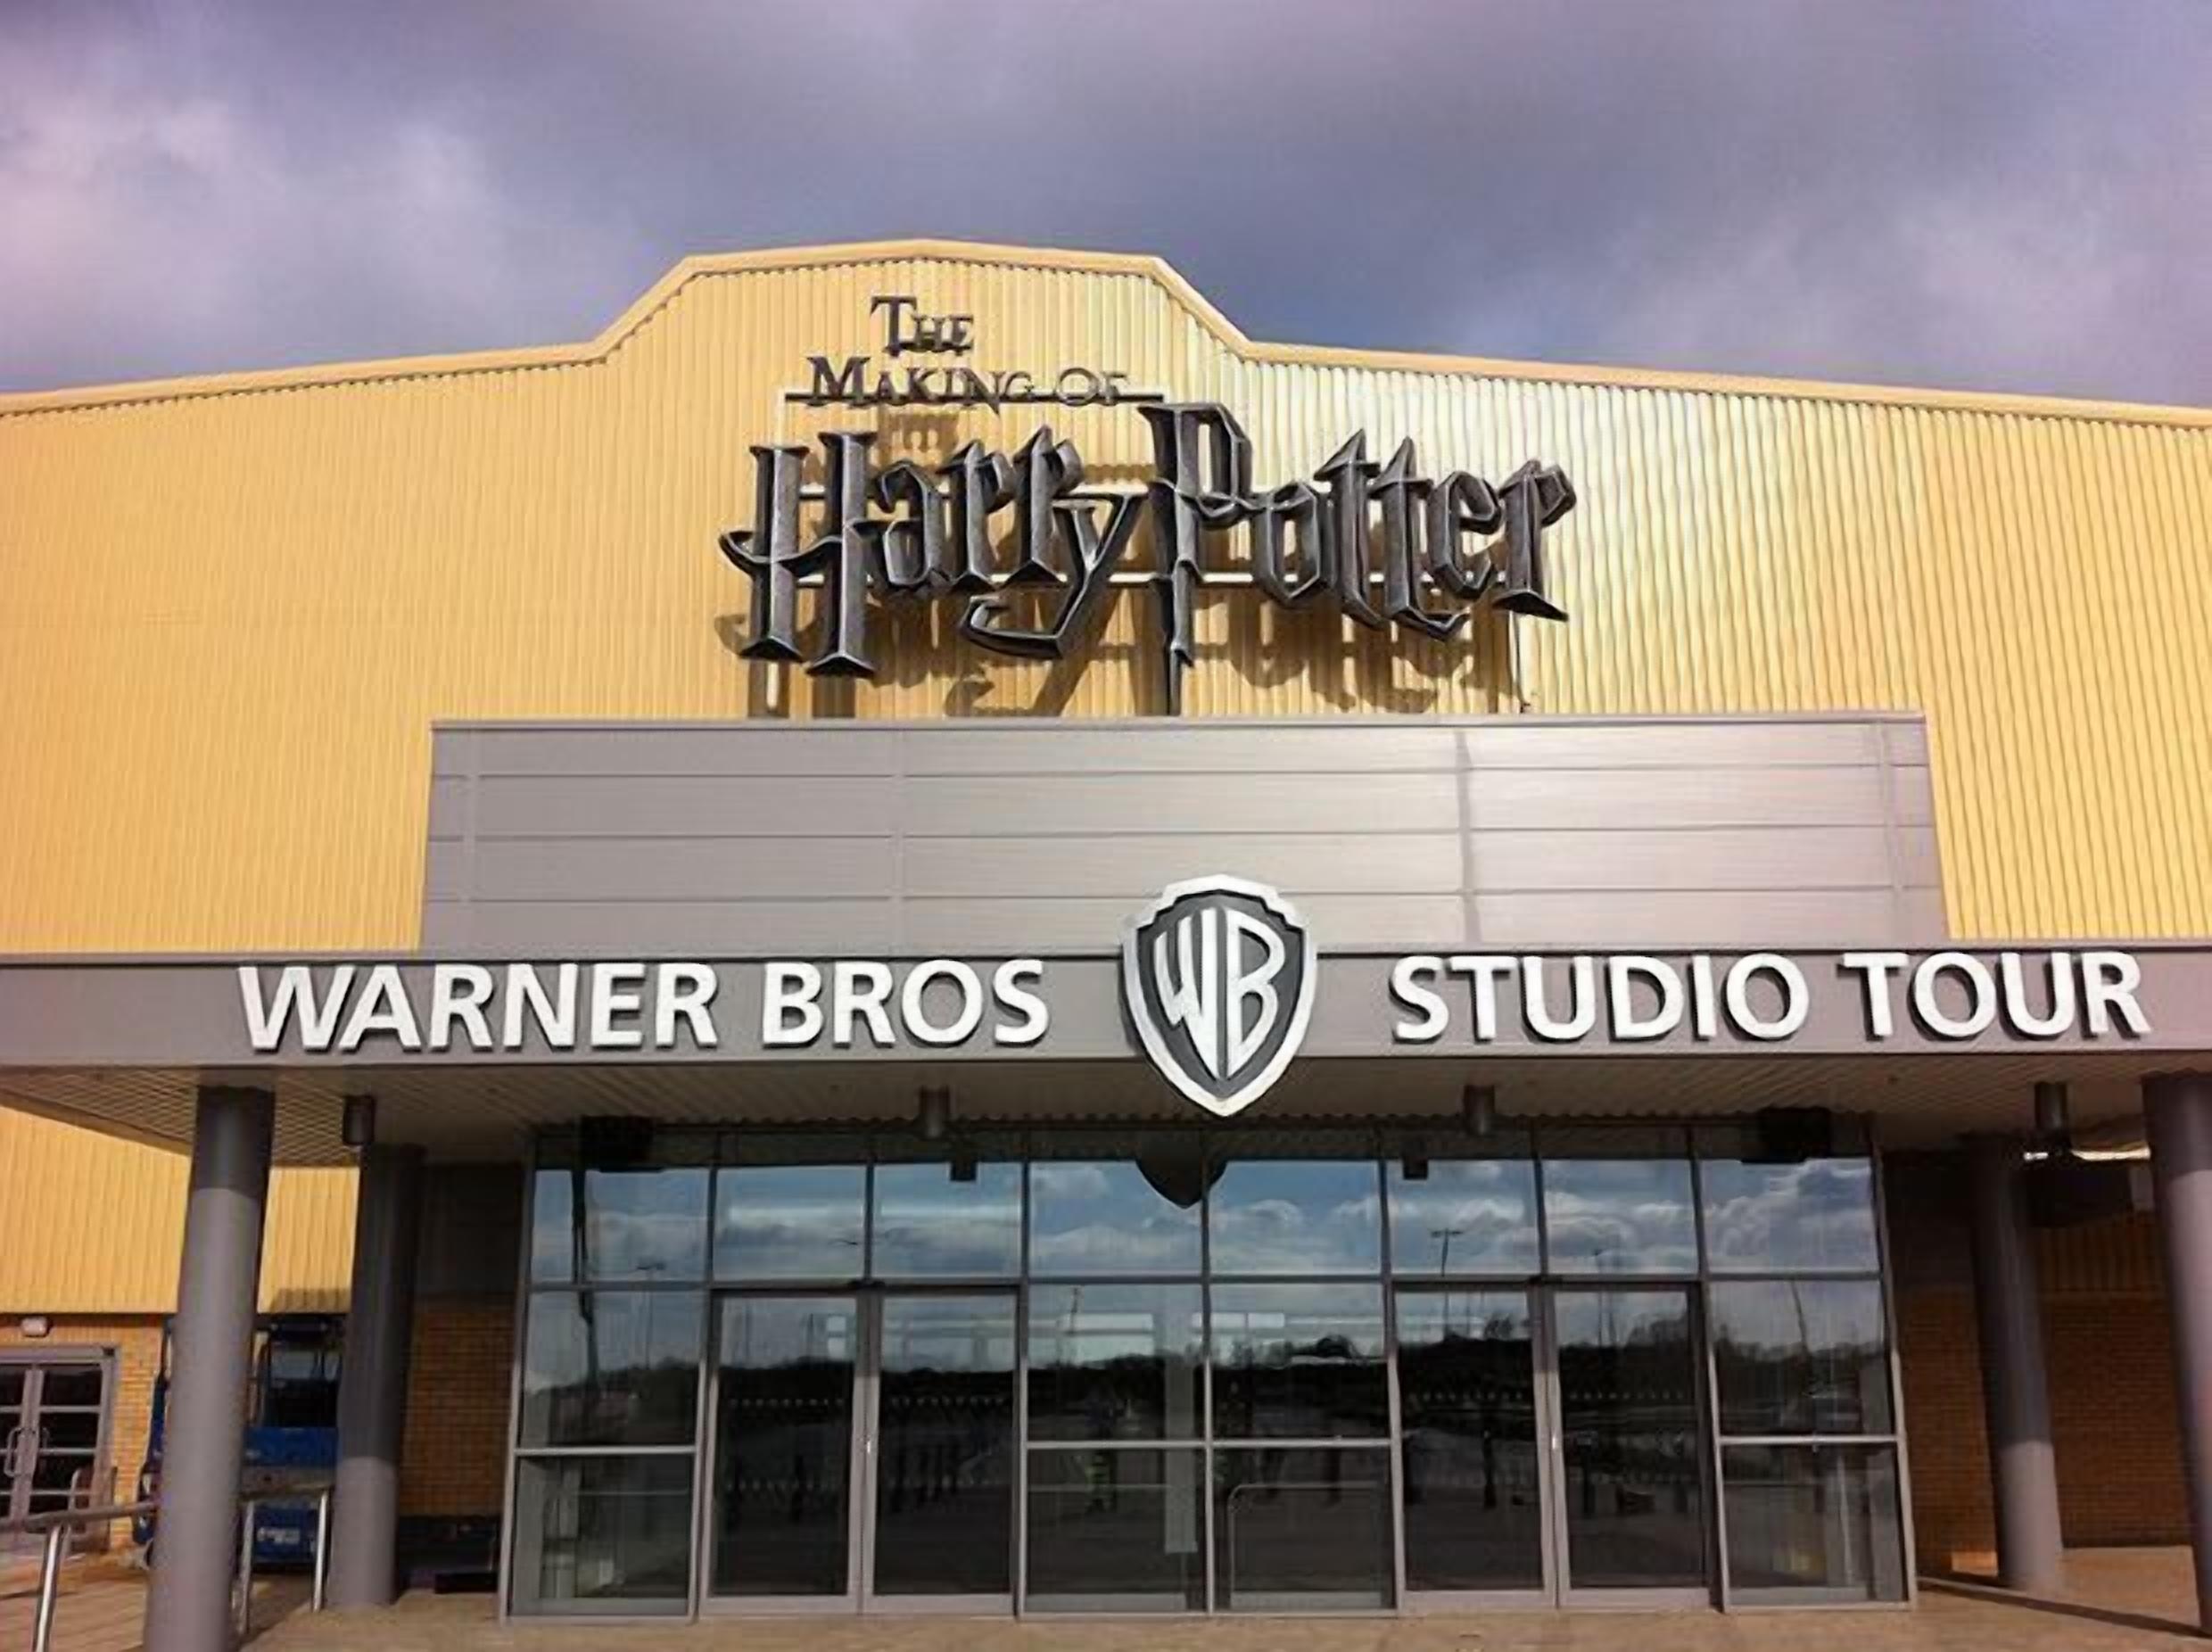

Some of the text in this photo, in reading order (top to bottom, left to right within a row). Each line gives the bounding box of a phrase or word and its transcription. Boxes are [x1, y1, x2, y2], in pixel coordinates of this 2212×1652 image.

[719, 401, 1577, 677] Harry Potter
[237, 959, 1051, 1053] WARNER BROS
[1153, 906, 1285, 1081] WB
[1390, 950, 2151, 1042] STUDIO TOUR
